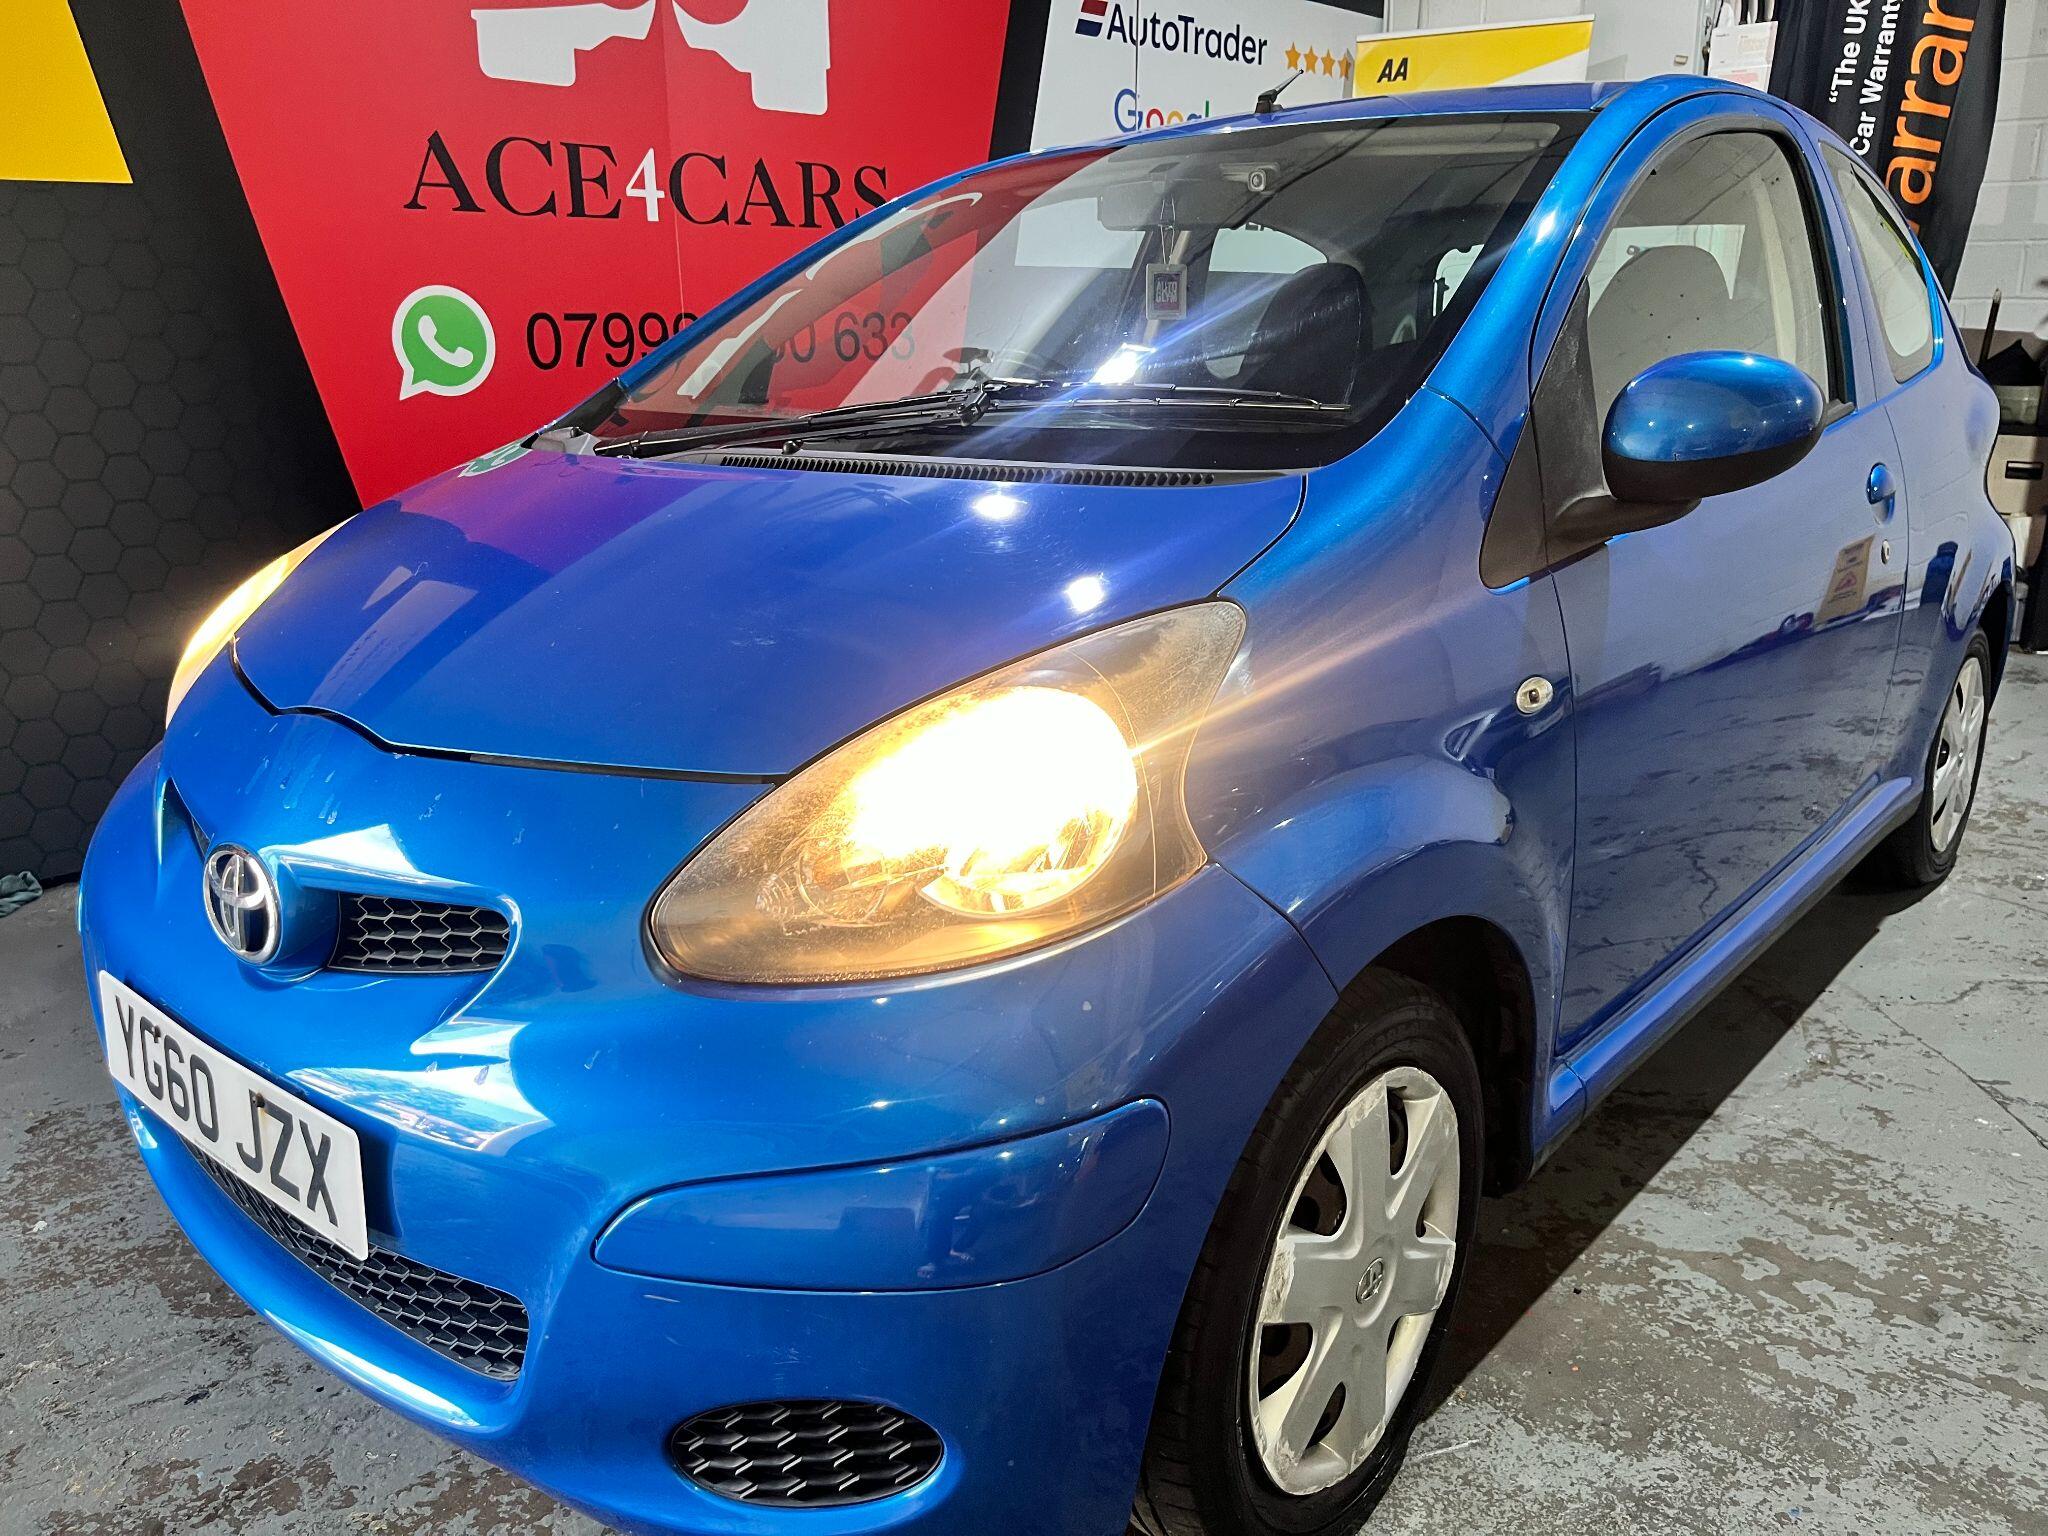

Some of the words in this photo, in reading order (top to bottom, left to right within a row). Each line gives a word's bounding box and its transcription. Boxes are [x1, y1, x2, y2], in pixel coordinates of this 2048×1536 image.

[1105, 1, 1268, 65] AutoTrader
[1859, 0, 1904, 104] Warrant
[1377, 57, 1409, 83] AA
[1849, 111, 1876, 156] Car
[403, 129, 887, 229] ACE4CARS
[834, 311, 916, 362] 633
[115, 995, 220, 1144] YG60
[236, 1088, 339, 1228] JZX
